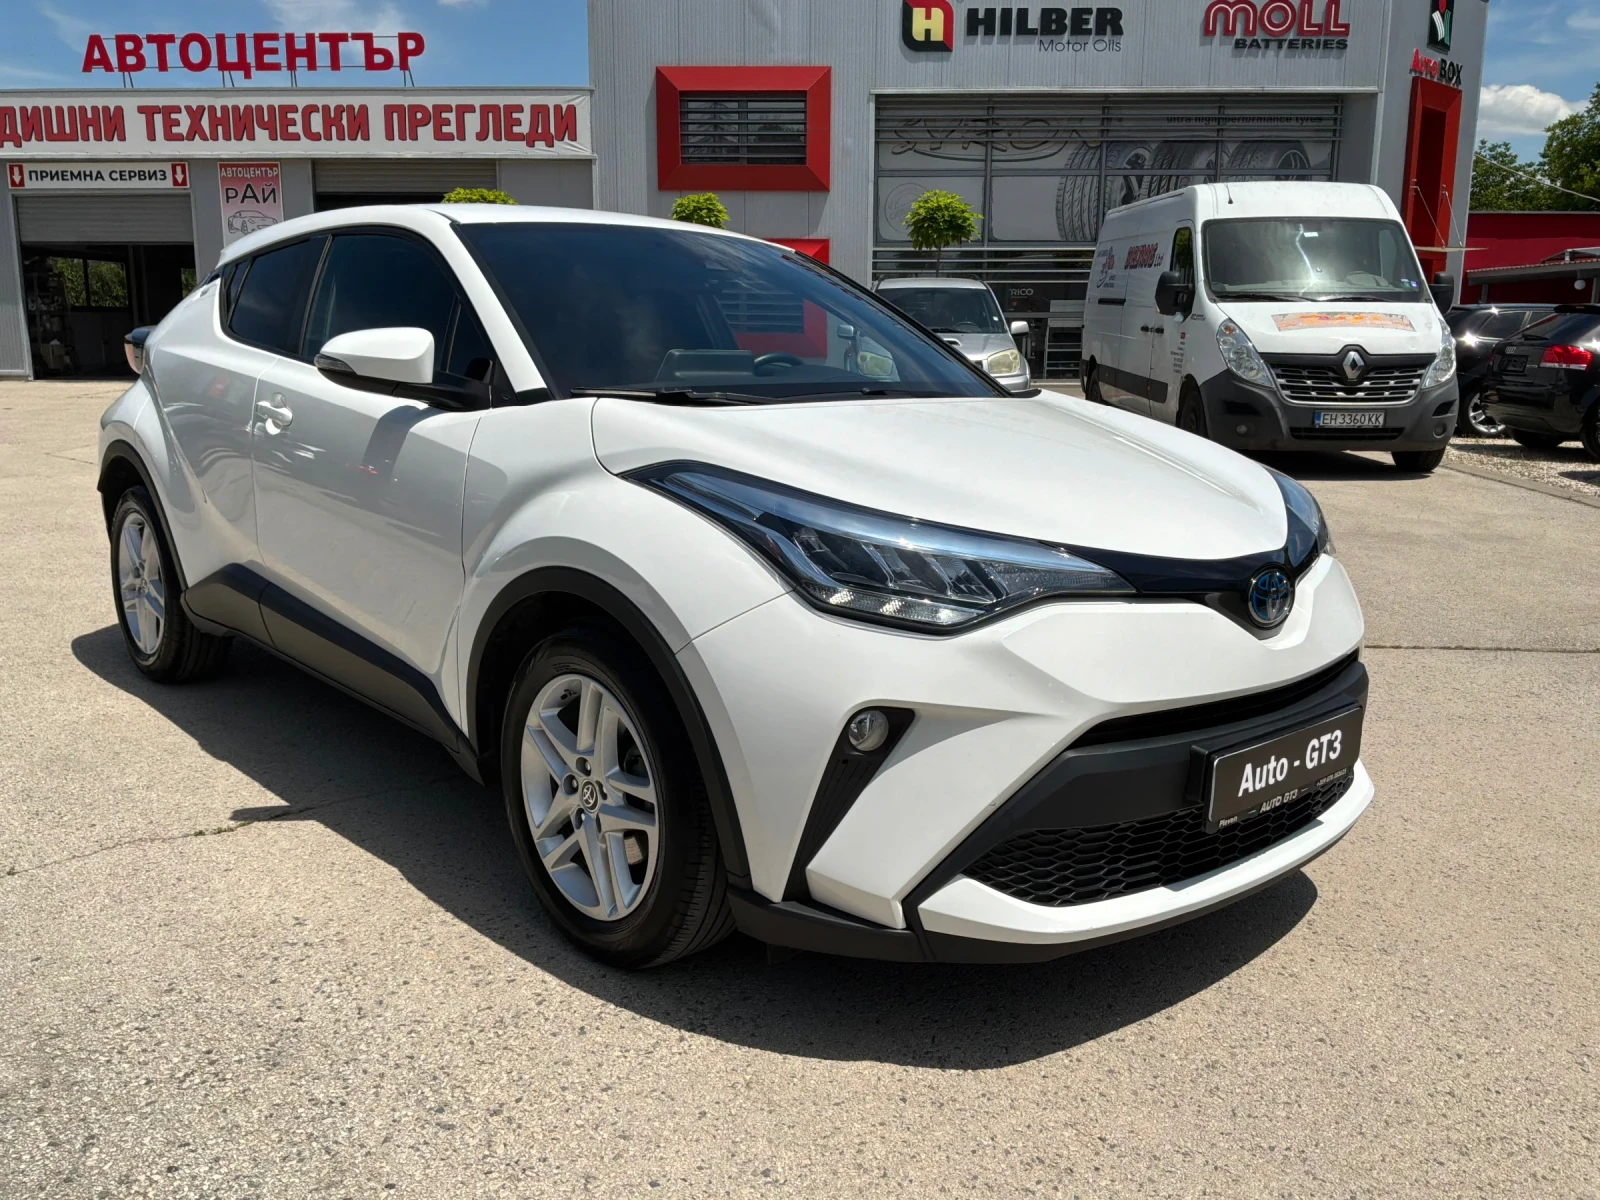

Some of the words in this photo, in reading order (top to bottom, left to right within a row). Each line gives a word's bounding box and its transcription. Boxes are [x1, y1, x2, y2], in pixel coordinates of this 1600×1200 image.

[967, 7, 1124, 36] HILBER
[1204, 0, 1350, 37] MOLL
[1039, 39, 1088, 52] Motor
[1093, 39, 1122, 52] Oils
[1234, 38, 1348, 49] BATTERIES
[82, 32, 425, 79] АВТОЦЕНТЪР
[0, 105, 126, 149] ДИШНИ
[137, 104, 370, 142] ТЕХНИЧЕСКИ
[383, 103, 577, 148] ПРЕГЛЕДИ
[28, 169, 105, 182] ПРИЕМНА
[109, 169, 167, 182] СЕРВИЗ
[220, 167, 279, 179] АВТОЦЕНТЪР
[225, 182, 276, 204] РАЙ
[1339, 413, 1366, 425] 3360
[1237, 755, 1289, 798] Auto
[1305, 729, 1342, 770] GT3
[1260, 799, 1282, 814] AUTO
[1283, 788, 1299, 804] GT3
[1218, 815, 1238, 828] Pleven
